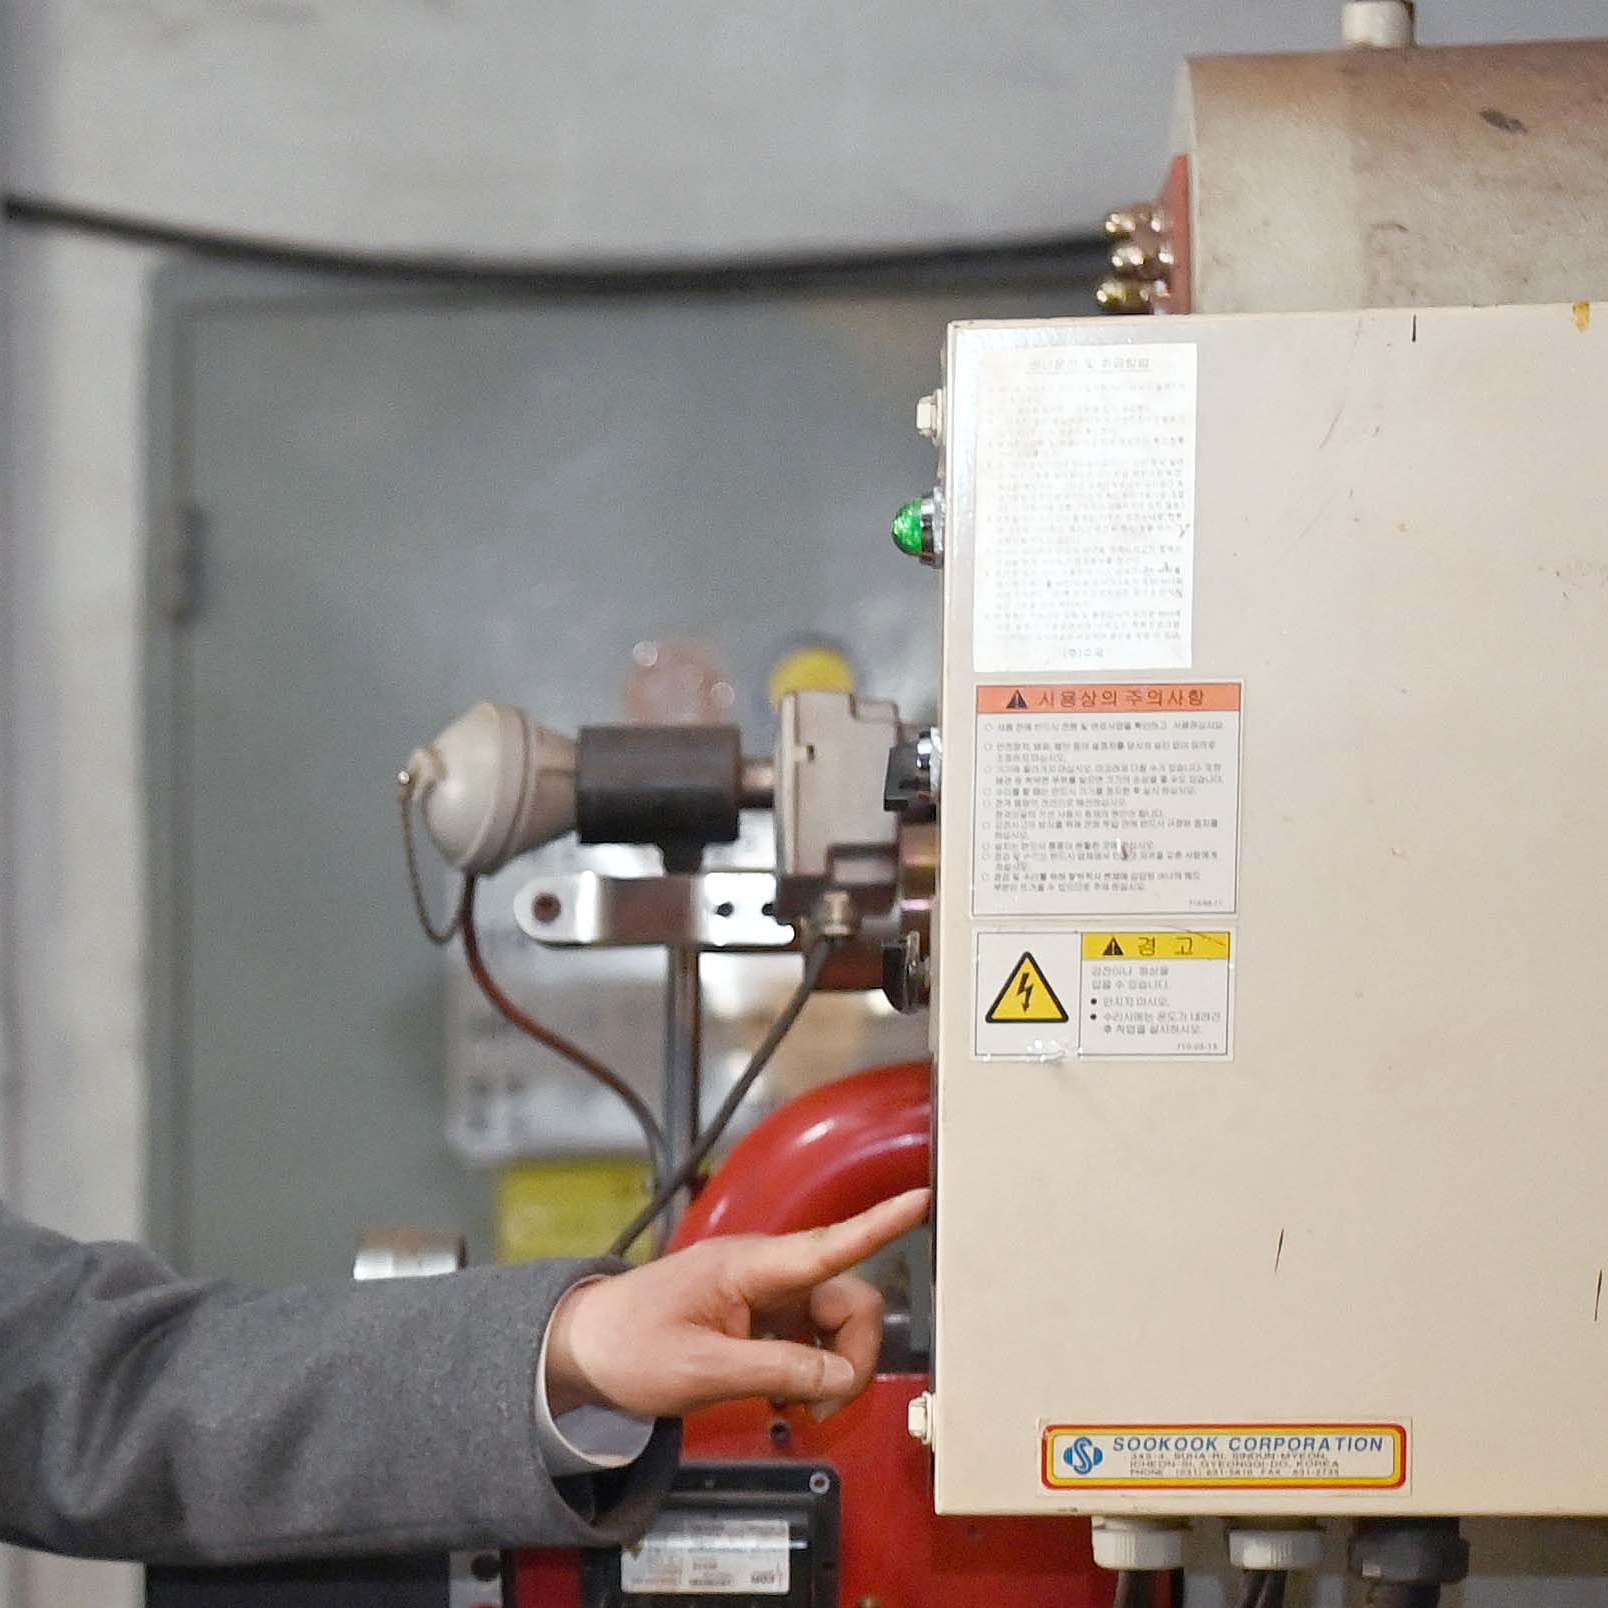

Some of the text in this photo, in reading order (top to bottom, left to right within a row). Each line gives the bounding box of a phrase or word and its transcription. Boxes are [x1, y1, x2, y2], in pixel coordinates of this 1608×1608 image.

[1038, 688, 1205, 708] 사용상의 주의사항
[1112, 1436, 1384, 1452] SOOKOOK CORPORATION
